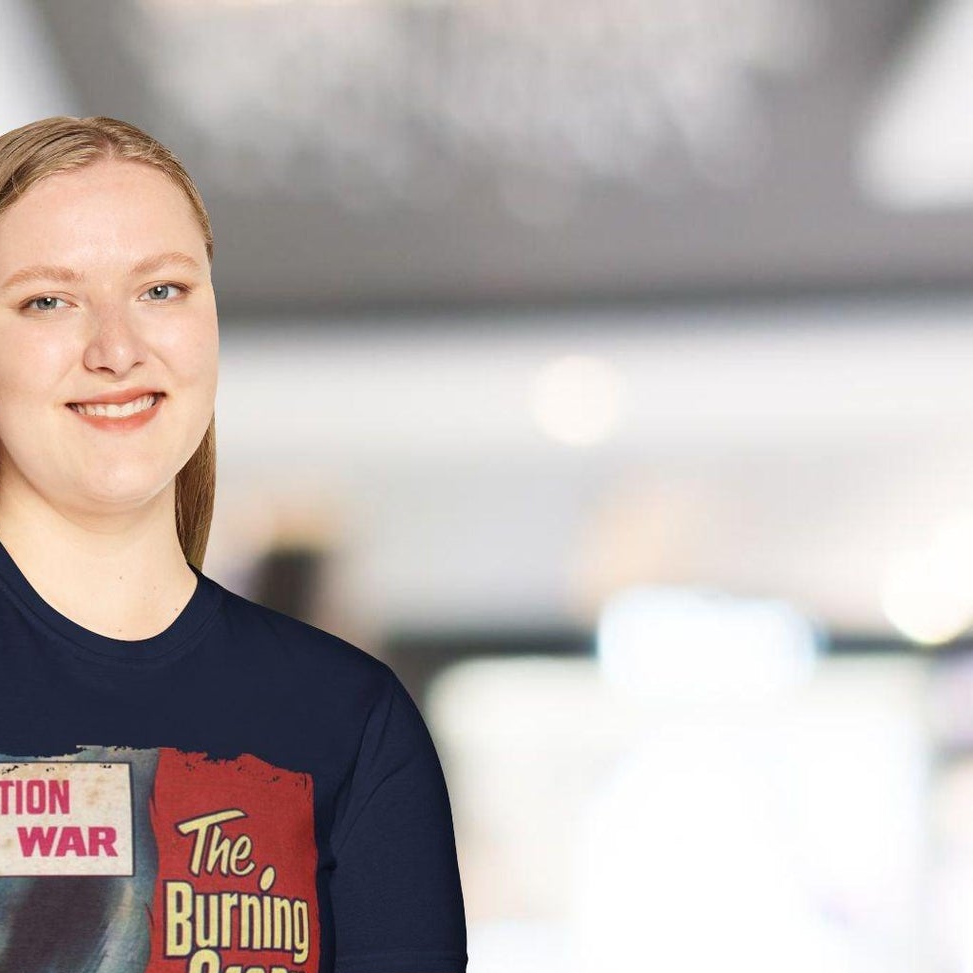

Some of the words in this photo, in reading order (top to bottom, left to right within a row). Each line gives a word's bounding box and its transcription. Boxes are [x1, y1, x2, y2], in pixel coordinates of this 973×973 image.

[17, 826, 118, 857] WAR
[177, 808, 256, 876] The
[165, 866, 309, 963] Burning
